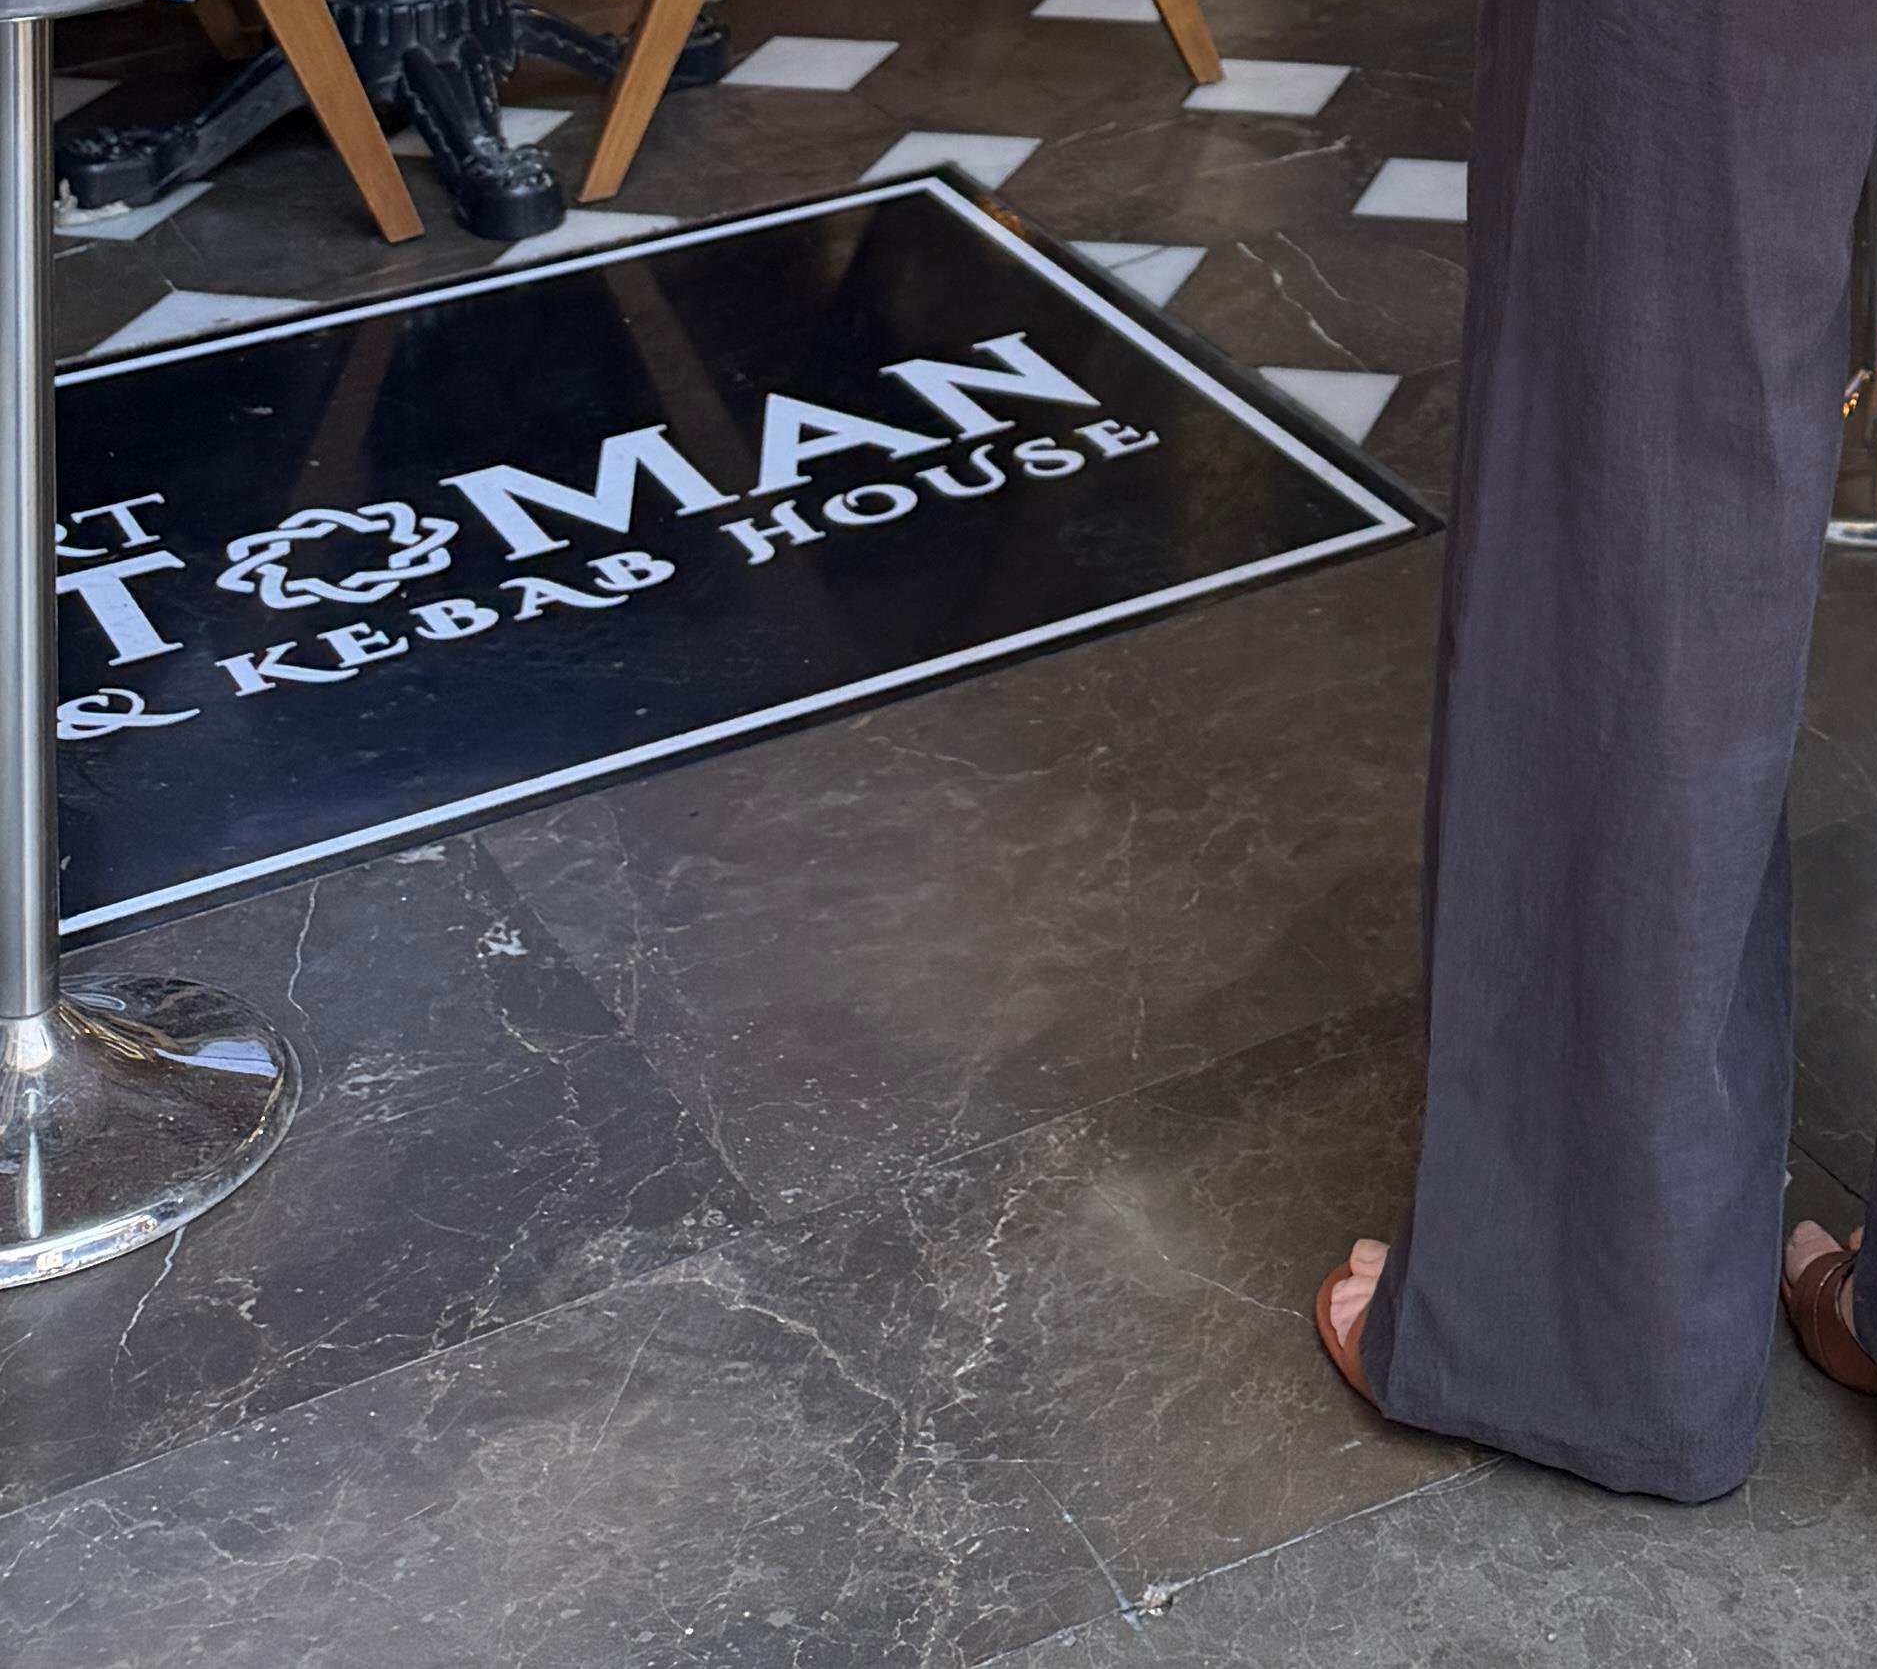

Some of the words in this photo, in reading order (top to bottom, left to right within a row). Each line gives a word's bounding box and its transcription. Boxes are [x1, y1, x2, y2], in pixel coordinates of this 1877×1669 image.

[57, 688, 200, 740] &
[215, 551, 675, 696] KEBAB
[720, 419, 1159, 565] HOUSE
